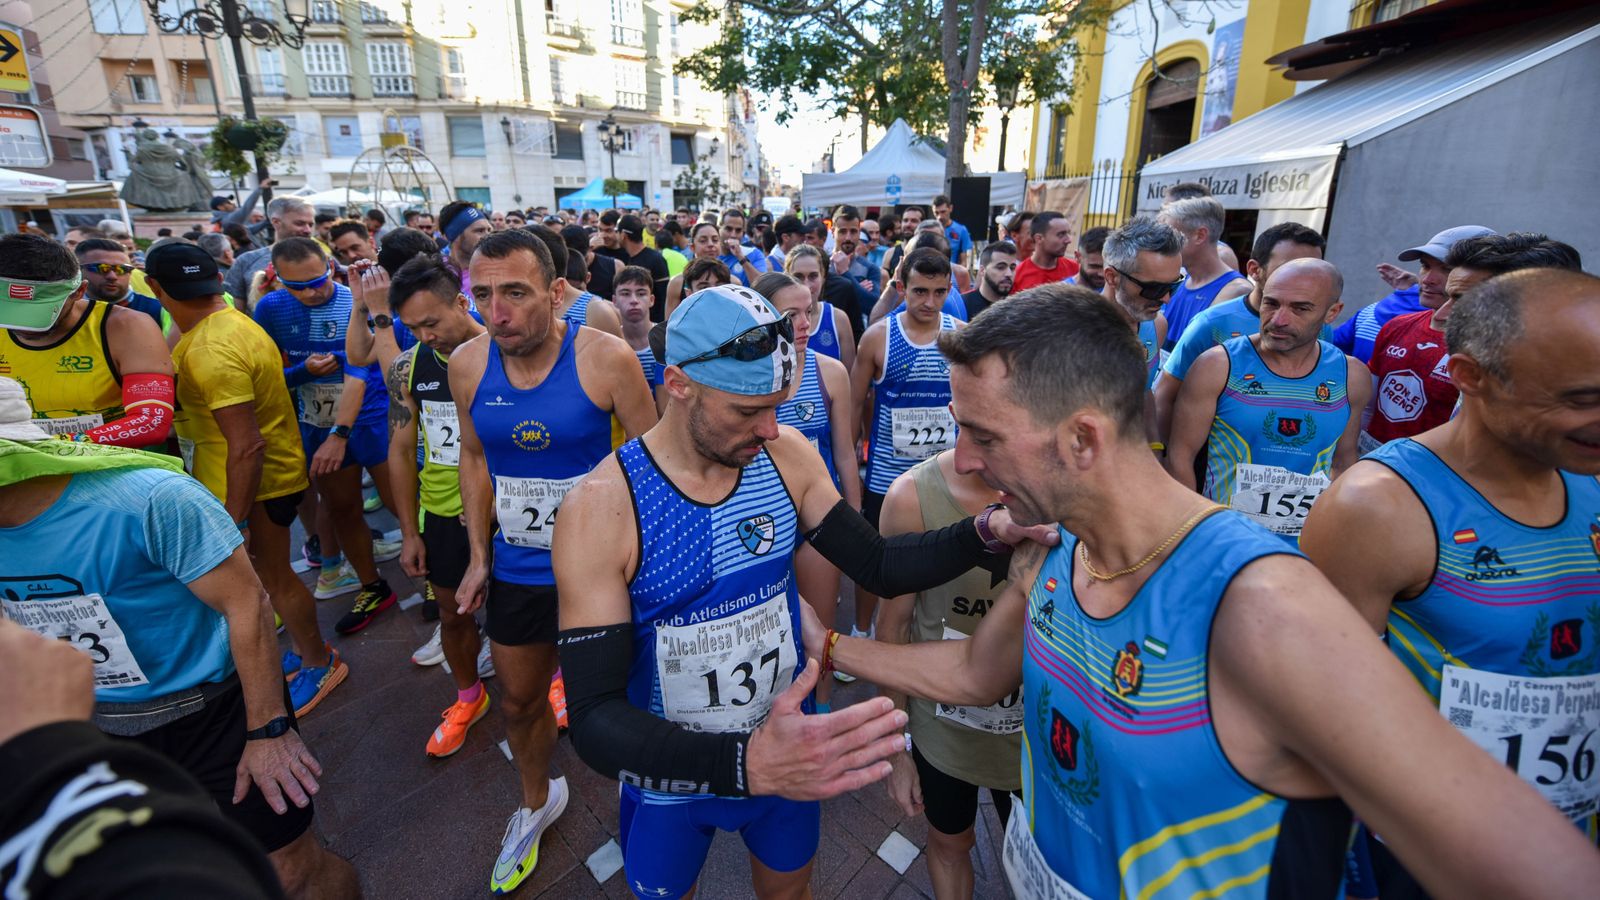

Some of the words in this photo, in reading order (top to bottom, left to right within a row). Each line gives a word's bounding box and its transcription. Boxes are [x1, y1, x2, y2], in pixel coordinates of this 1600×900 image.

[1244, 168, 1310, 199] Iglesia
[1382, 386, 1414, 413] FRENO
[1388, 378, 1421, 406] PONLE
[312, 400, 335, 417] 97
[93, 423, 121, 435] CLUB
[98, 407, 164, 443] ALGECIRAS
[513, 419, 529, 432] TEAM
[530, 419, 547, 432] BATH
[908, 427, 947, 446] 222
[500, 481, 545, 498] "Alcaldesa
[1240, 468, 1286, 485] "Alcaldesa
[1258, 492, 1315, 518] 155
[27, 583, 53, 592] C.A.L.
[689, 592, 756, 625] Atletismo
[710, 620, 740, 632] Carrera
[743, 607, 767, 622] Popular
[662, 632, 732, 656] "Alcaldesa
[735, 605, 783, 645] Perpetua"
[700, 647, 780, 708] 137
[1451, 678, 1550, 715] "Alcaldesa
[1497, 729, 1597, 786] 156
